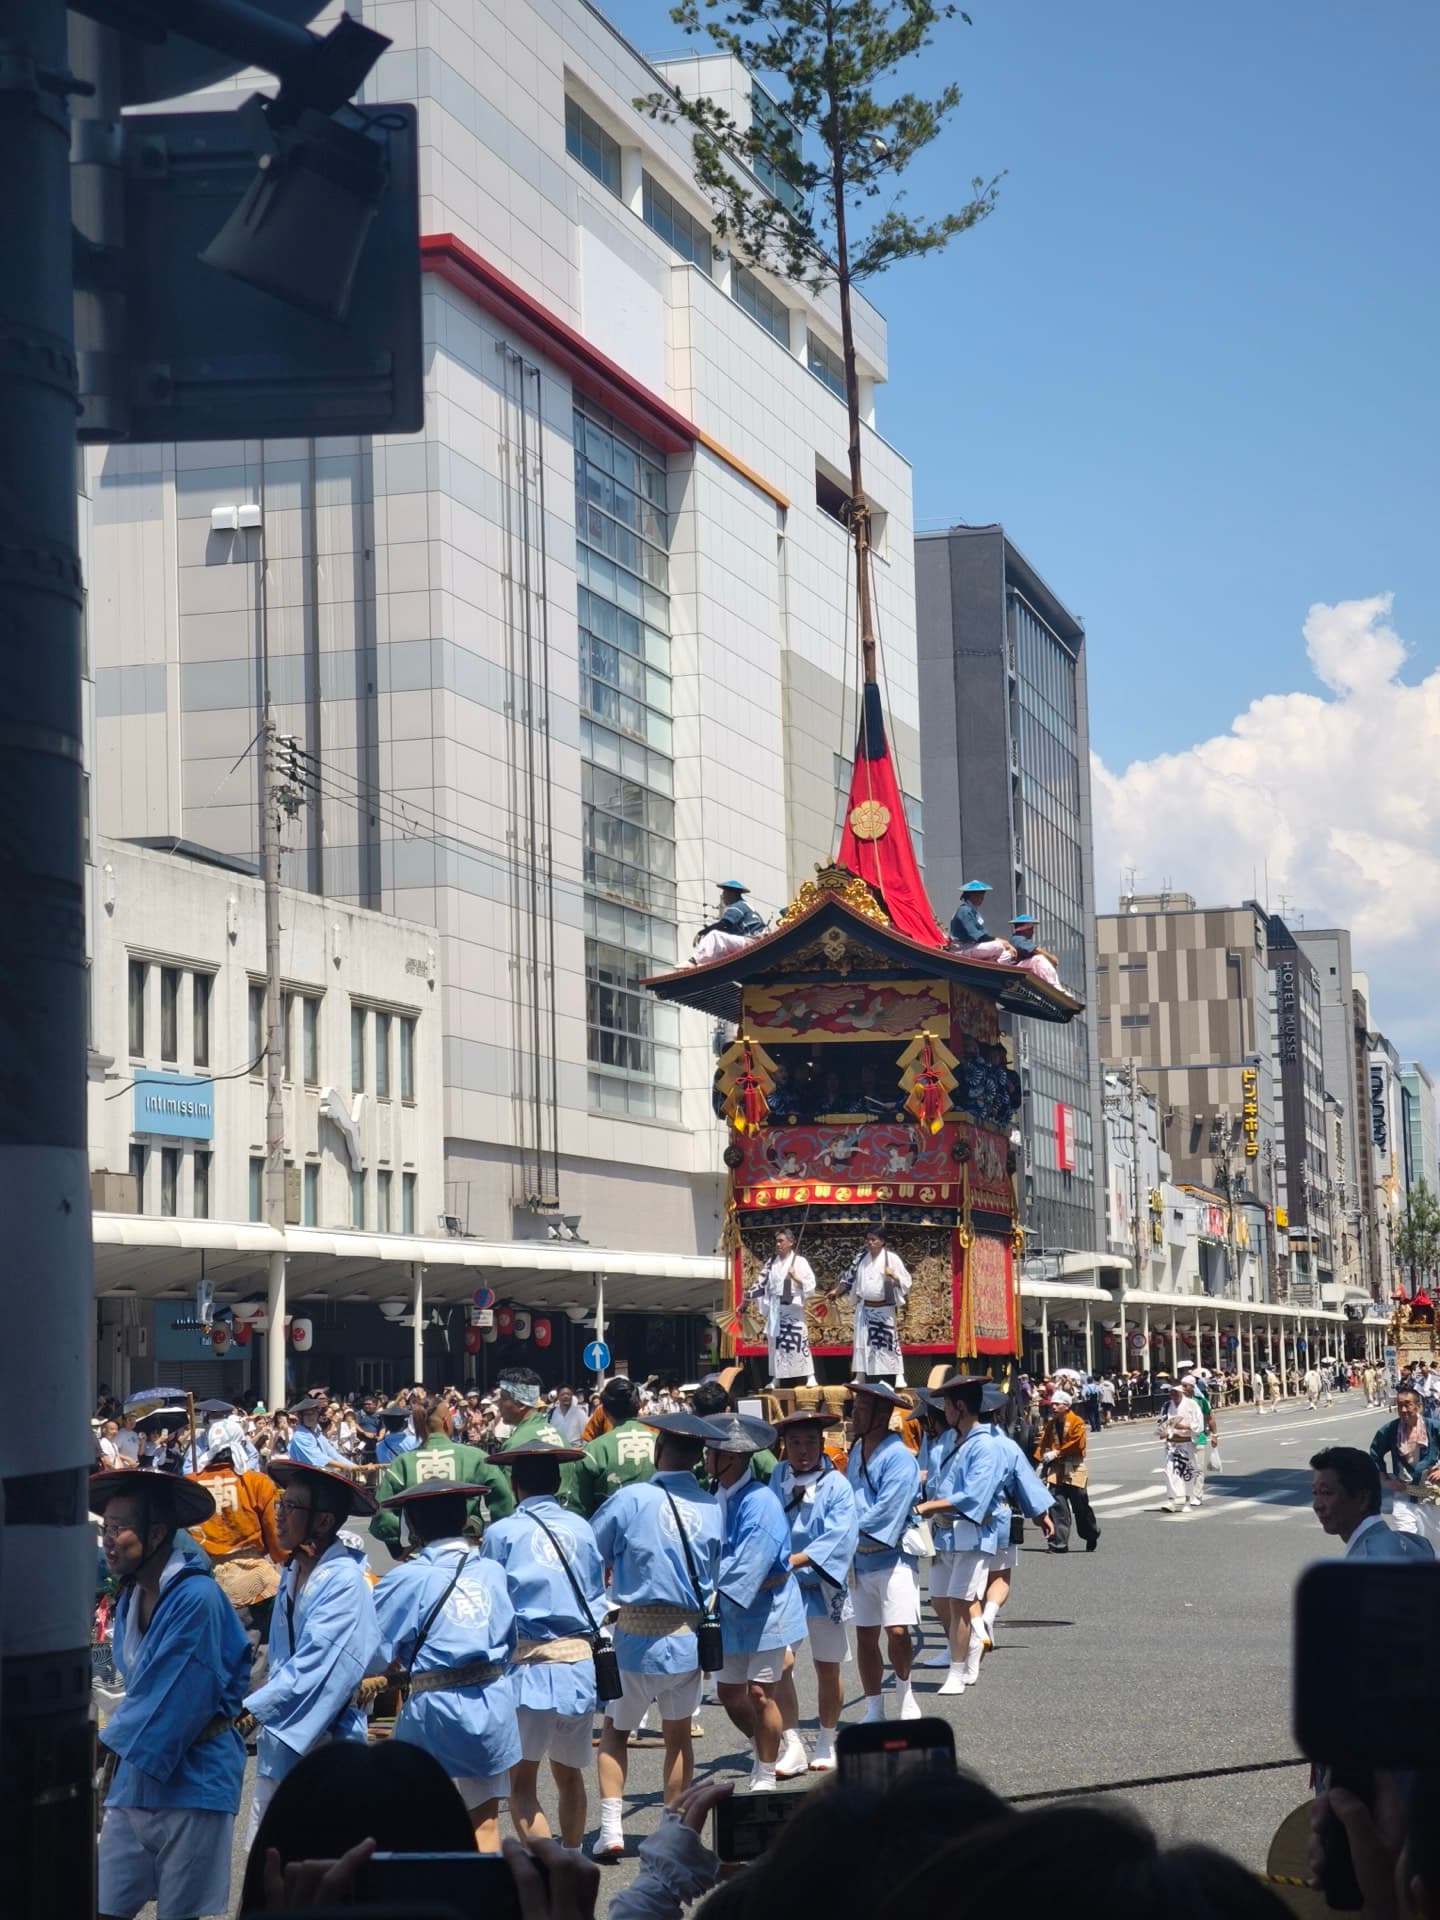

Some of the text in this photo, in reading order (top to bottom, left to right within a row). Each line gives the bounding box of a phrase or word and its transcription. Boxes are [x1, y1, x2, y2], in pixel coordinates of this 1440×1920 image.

[1282, 961, 1297, 1060] HOTEL MUSSE
[867, 1320, 894, 1352] 南
[616, 1429, 656, 1466] 南
[415, 1448, 456, 1484] 南
